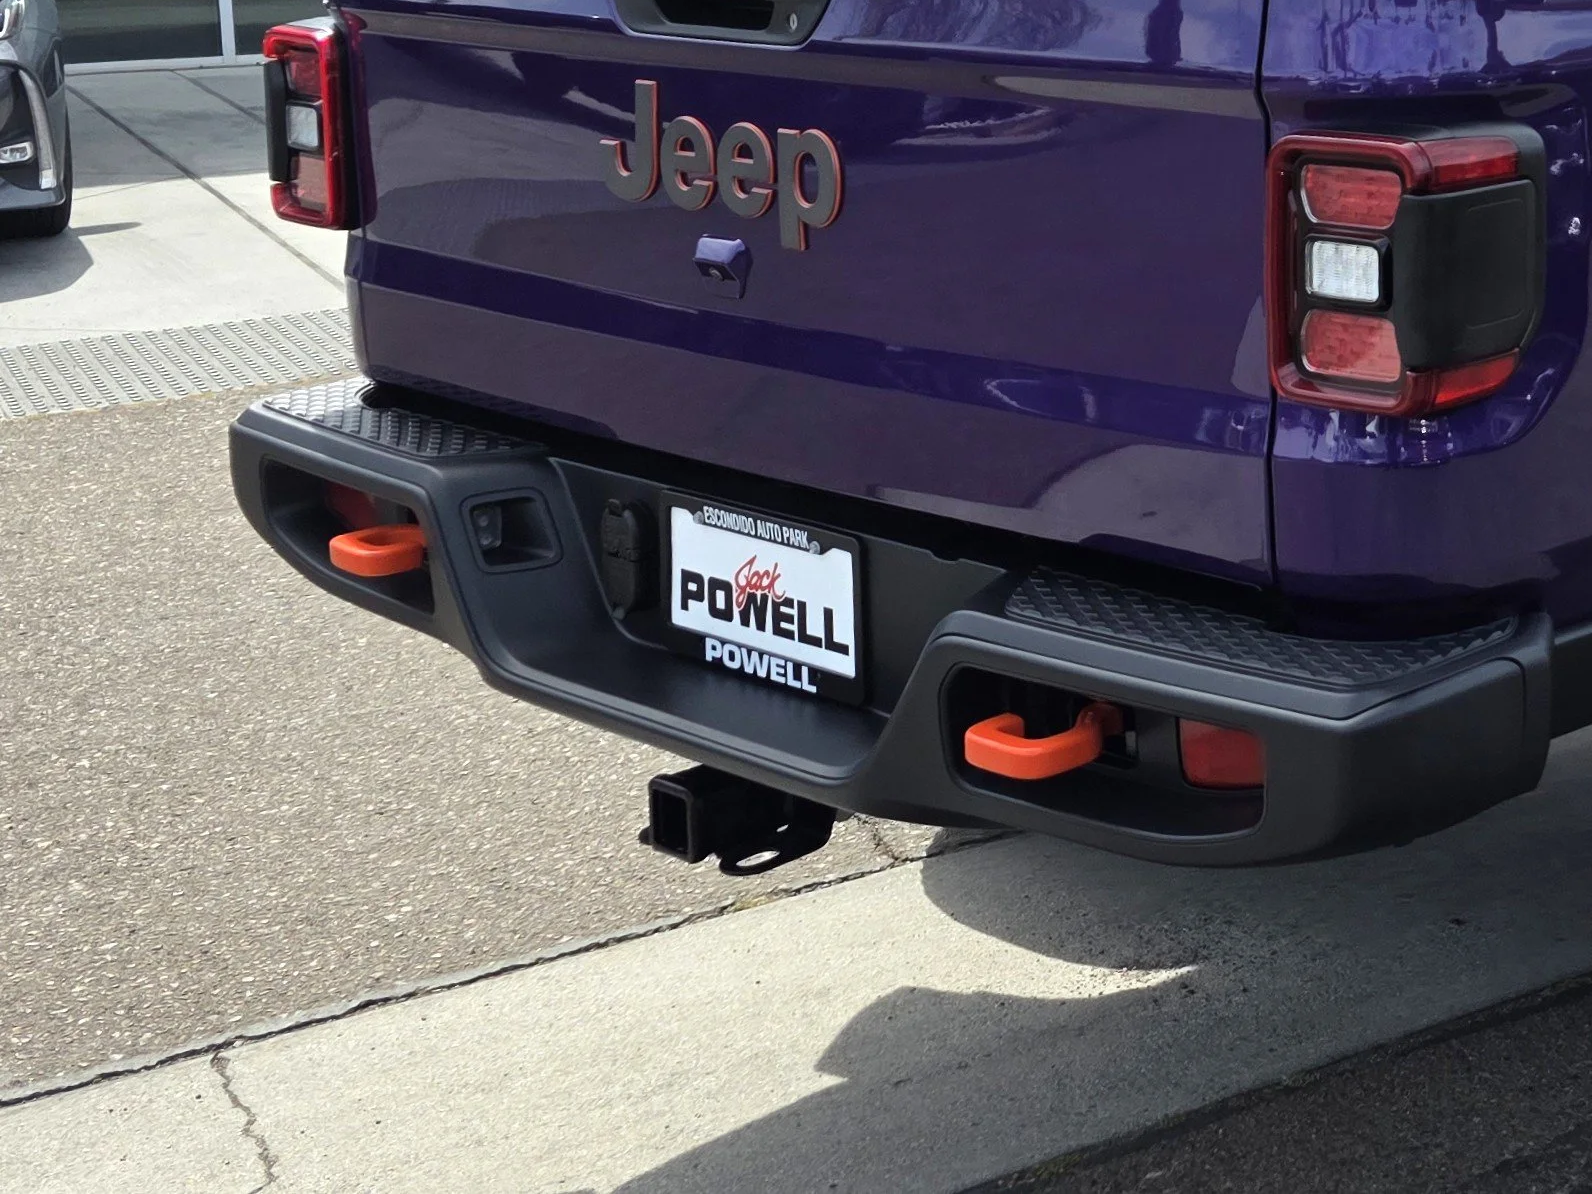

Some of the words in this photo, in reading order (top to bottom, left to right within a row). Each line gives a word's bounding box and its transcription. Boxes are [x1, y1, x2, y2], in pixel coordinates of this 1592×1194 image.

[599, 79, 843, 251] Jeep
[702, 506, 755, 536] ESCONDIDO
[757, 519, 782, 542] AUTO
[783, 526, 810, 549] PARK
[734, 554, 785, 610] Jack
[680, 568, 850, 656] POWELL
[704, 637, 817, 693] POWELL
